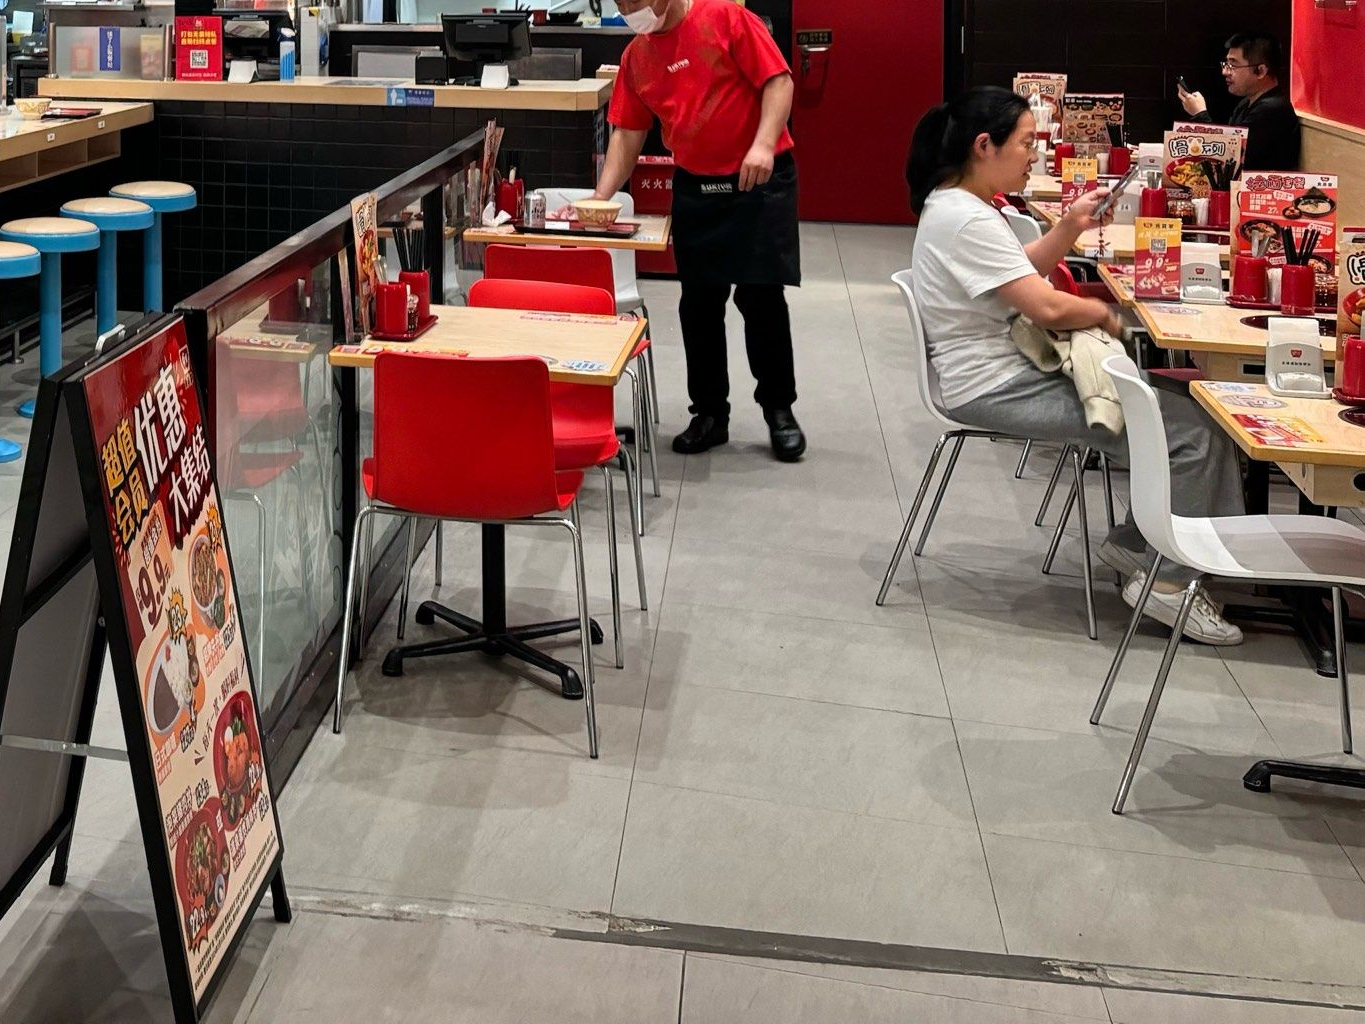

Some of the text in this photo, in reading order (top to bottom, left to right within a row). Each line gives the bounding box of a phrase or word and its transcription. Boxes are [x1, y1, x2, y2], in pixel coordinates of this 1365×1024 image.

[101, 416, 137, 498] 超值
[134, 361, 186, 494] 优惠
[114, 466, 149, 545] 会员
[168, 423, 211, 534] 大集结
